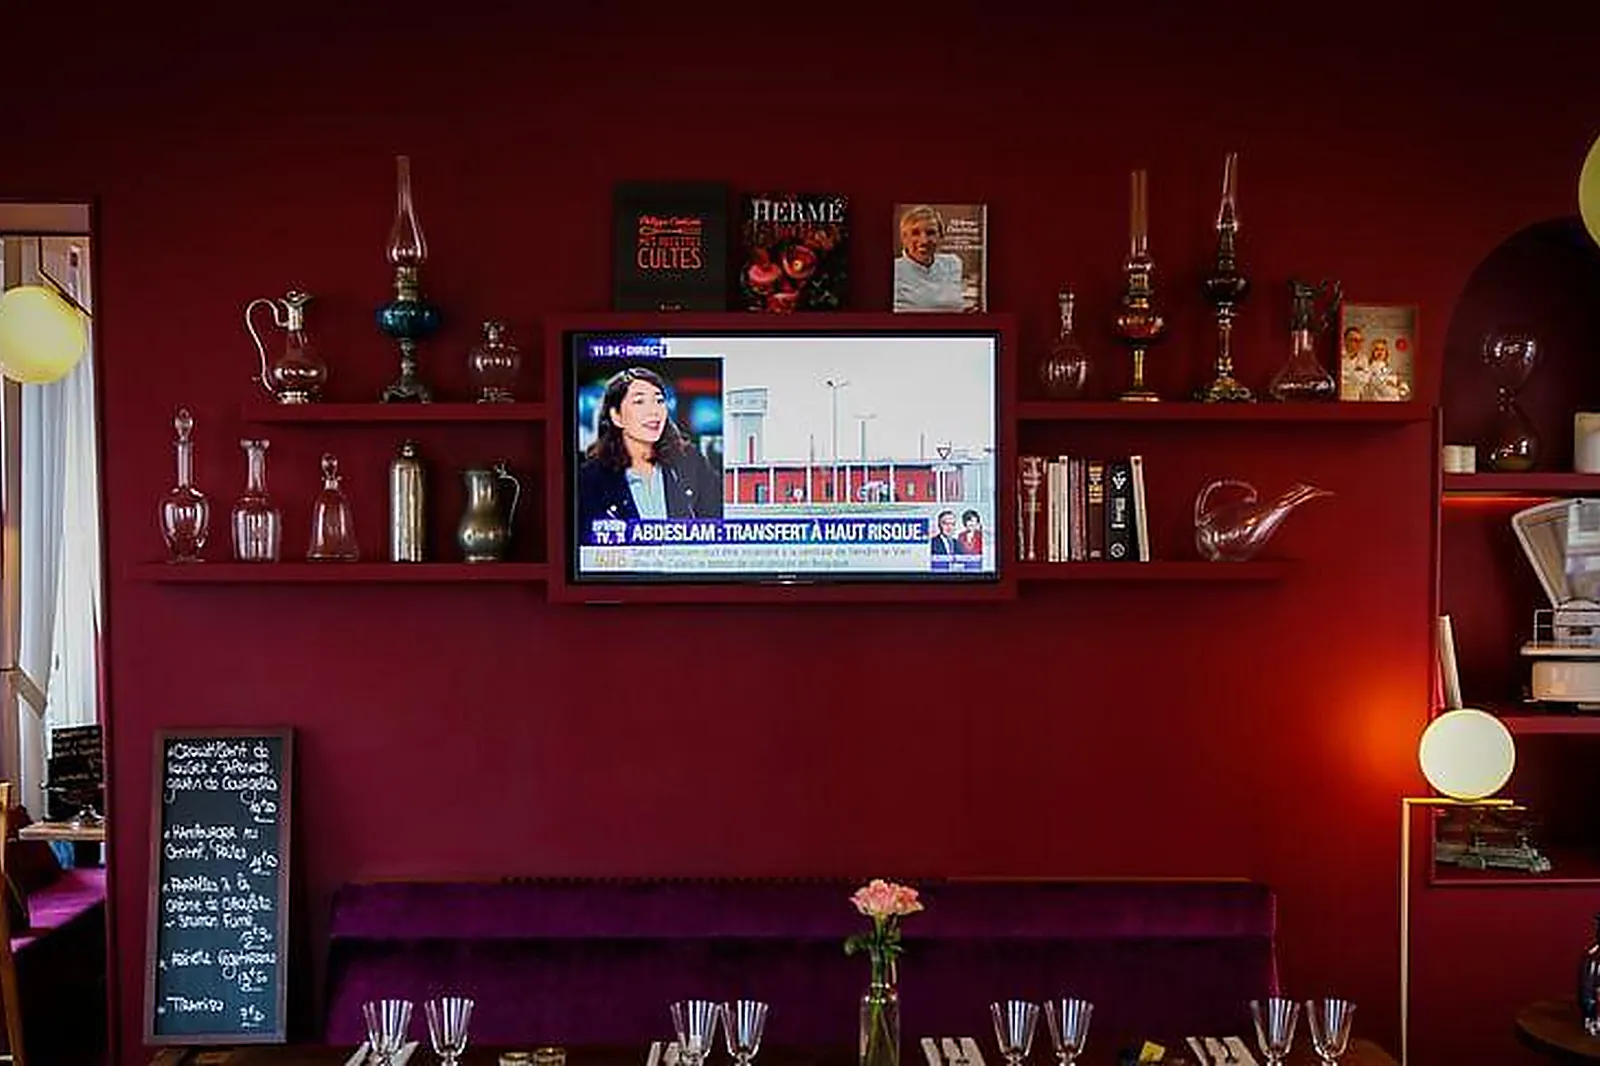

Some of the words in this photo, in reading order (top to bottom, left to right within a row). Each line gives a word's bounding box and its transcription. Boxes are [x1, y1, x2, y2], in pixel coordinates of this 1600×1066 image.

[753, 197, 844, 222] HERMÉ
[637, 247, 702, 269] CULTES
[725, 523, 807, 542] TRANSFERT
[811, 519, 823, 542] À
[824, 523, 866, 542] HAUT
